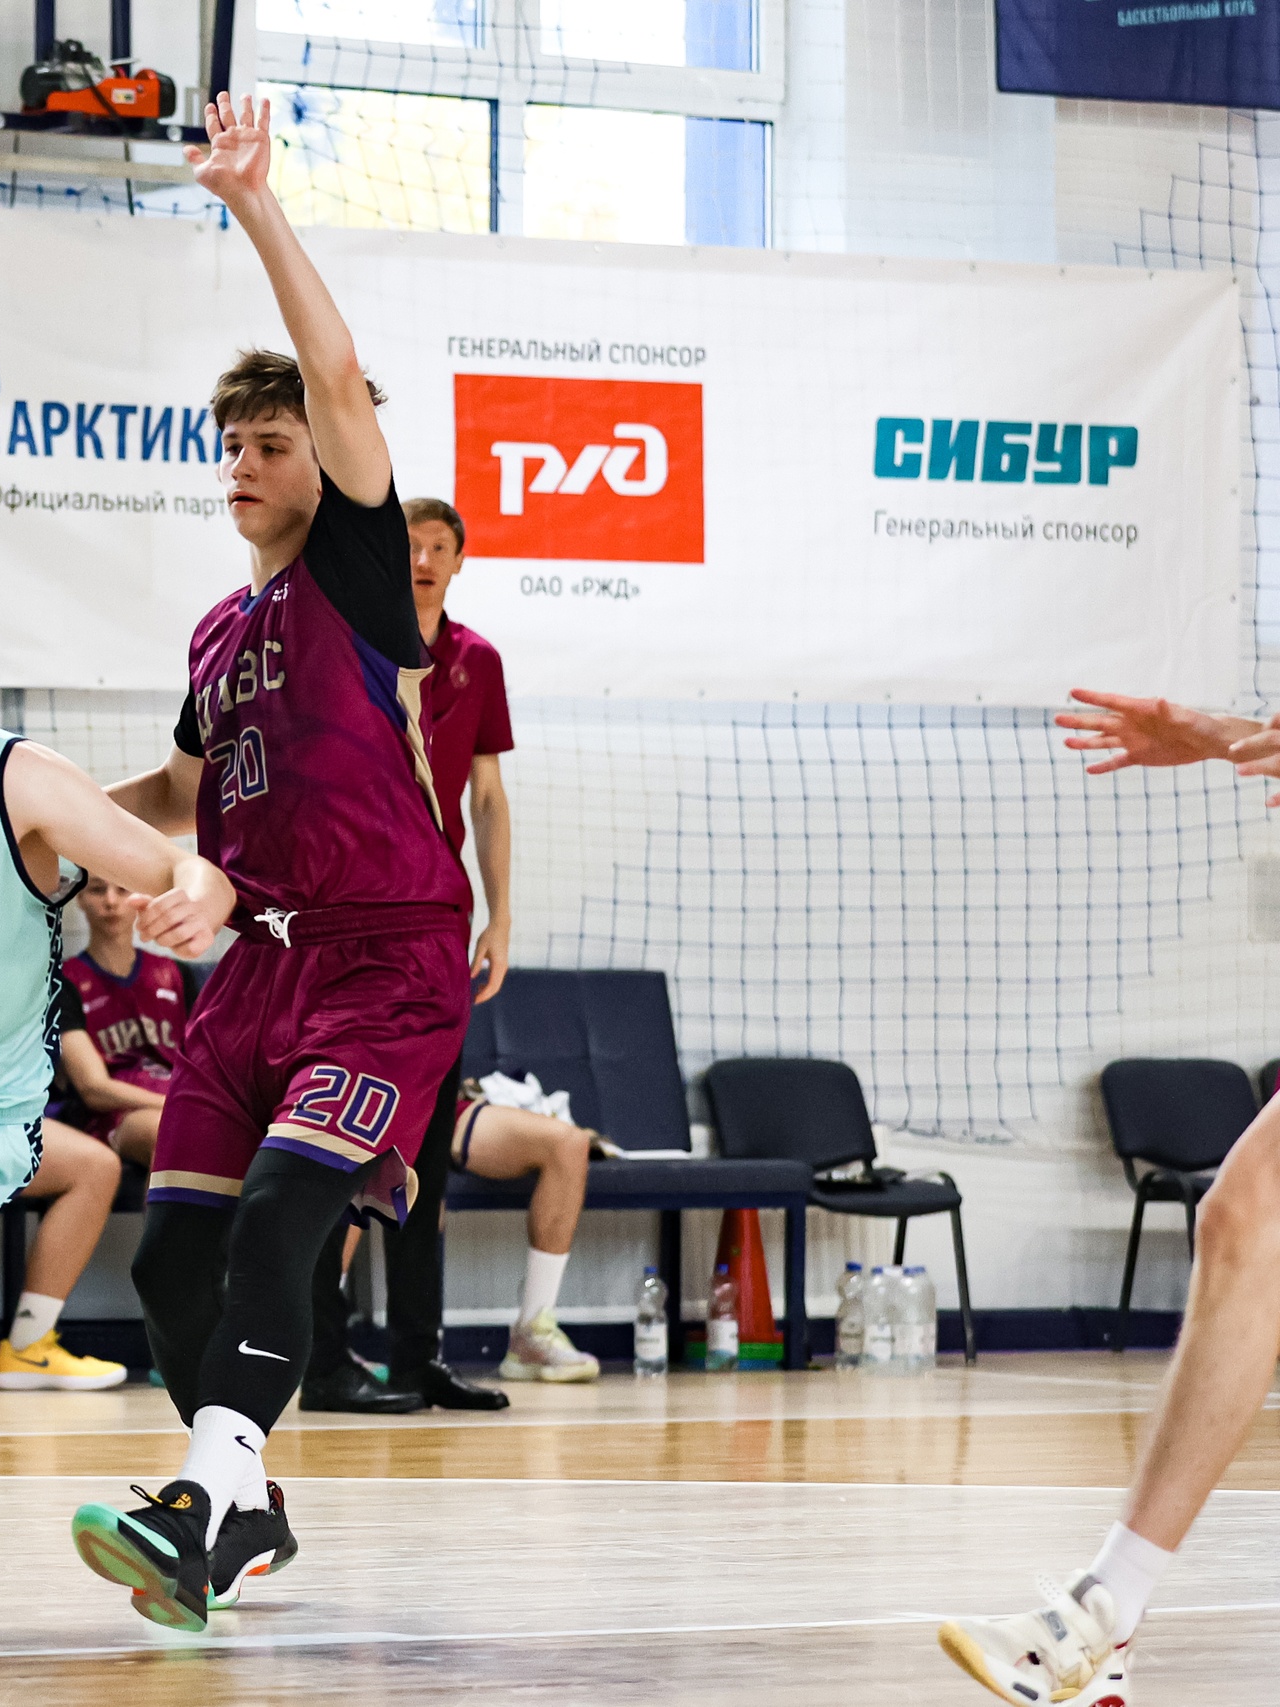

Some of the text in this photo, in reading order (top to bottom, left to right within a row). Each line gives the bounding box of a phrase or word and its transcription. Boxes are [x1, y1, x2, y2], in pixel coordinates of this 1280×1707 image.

[1224, 0, 1256, 17] КЛУБ
[447, 336, 706, 367] ГЕНЕРАЛЬНЫЙ СПОНСОР
[7, 401, 223, 464] АРКТИК
[874, 416, 1139, 486] СИБУР
[173, 494, 226, 520] парт
[873, 509, 1138, 548] Генеральный спонсор
[520, 575, 640, 600] ОАО «РЖД»
[206, 725, 269, 814] 20
[287, 1065, 401, 1148] 20
